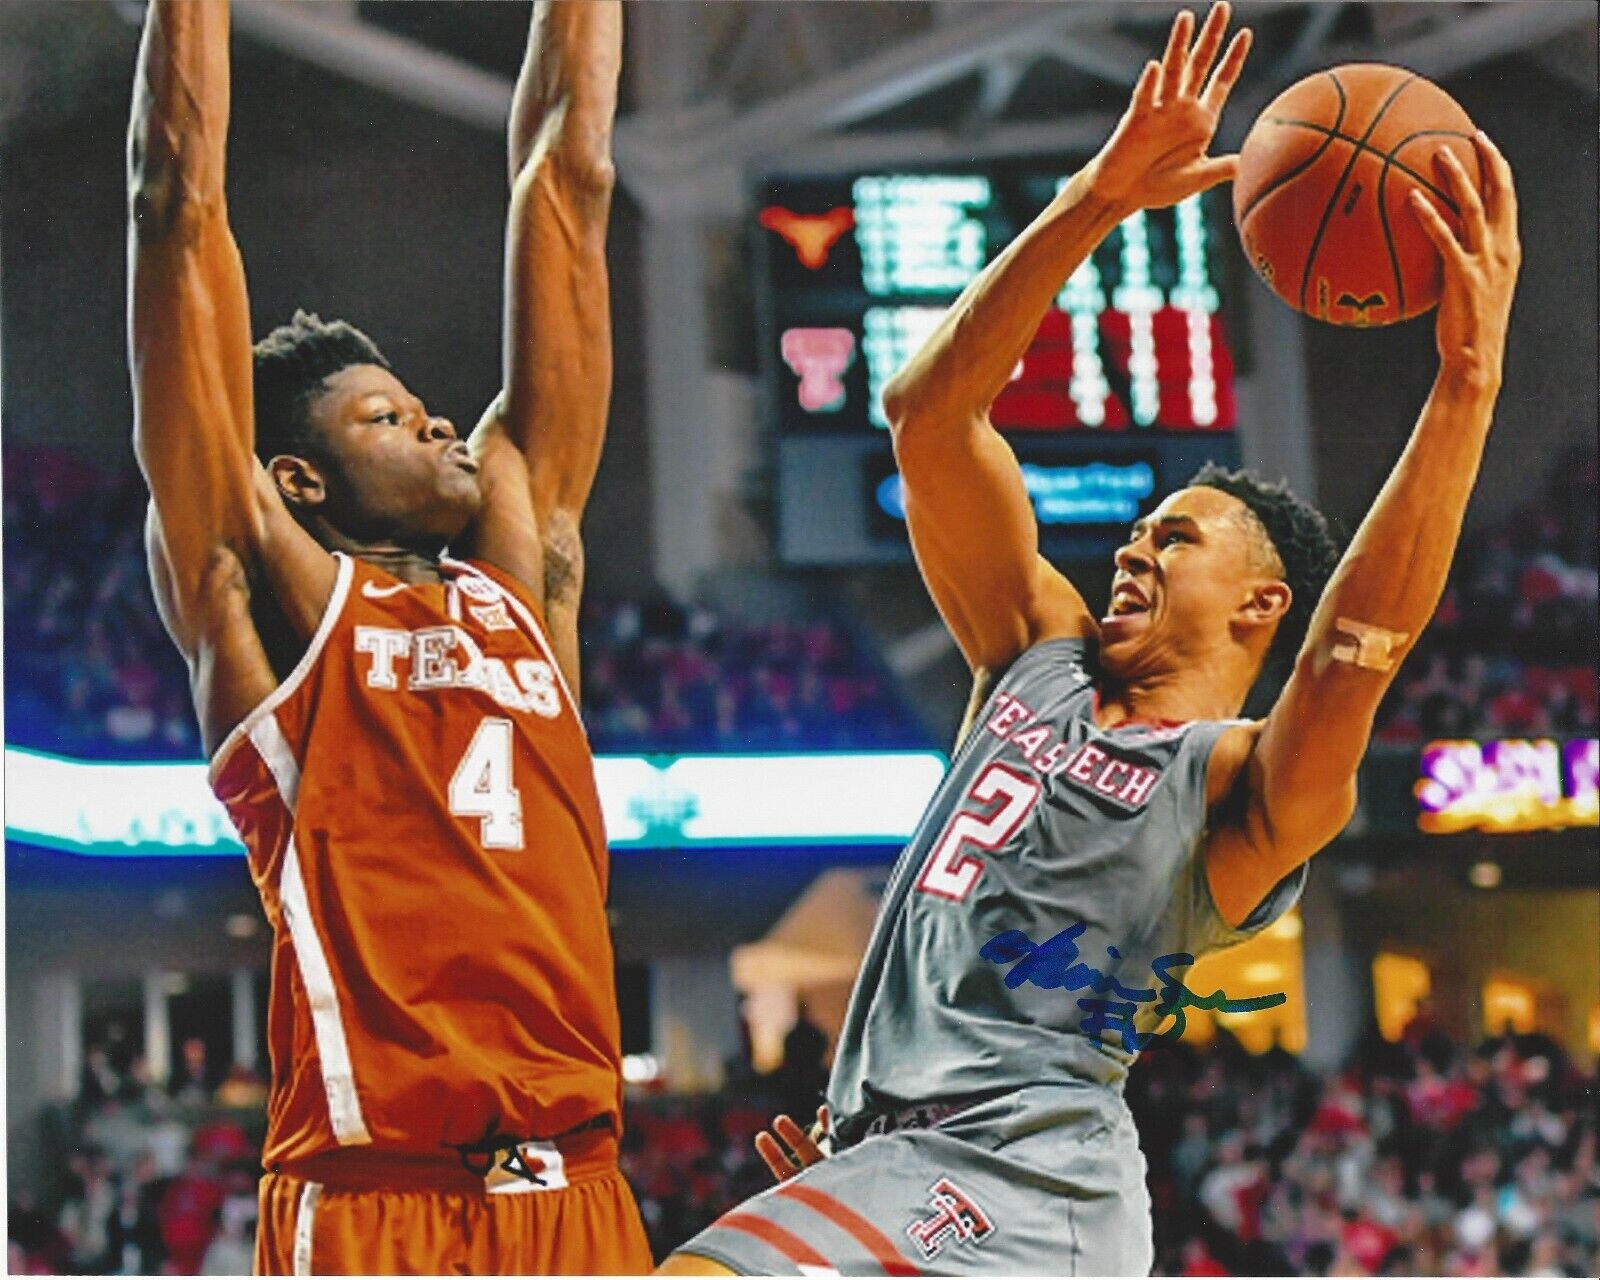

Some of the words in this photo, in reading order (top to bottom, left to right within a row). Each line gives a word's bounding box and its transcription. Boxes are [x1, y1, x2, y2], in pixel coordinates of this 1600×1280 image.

[448, 716, 525, 850] 4
[986, 690, 1067, 775] EAS
[1055, 741, 1160, 807] ECH
[916, 760, 1042, 905] 2
